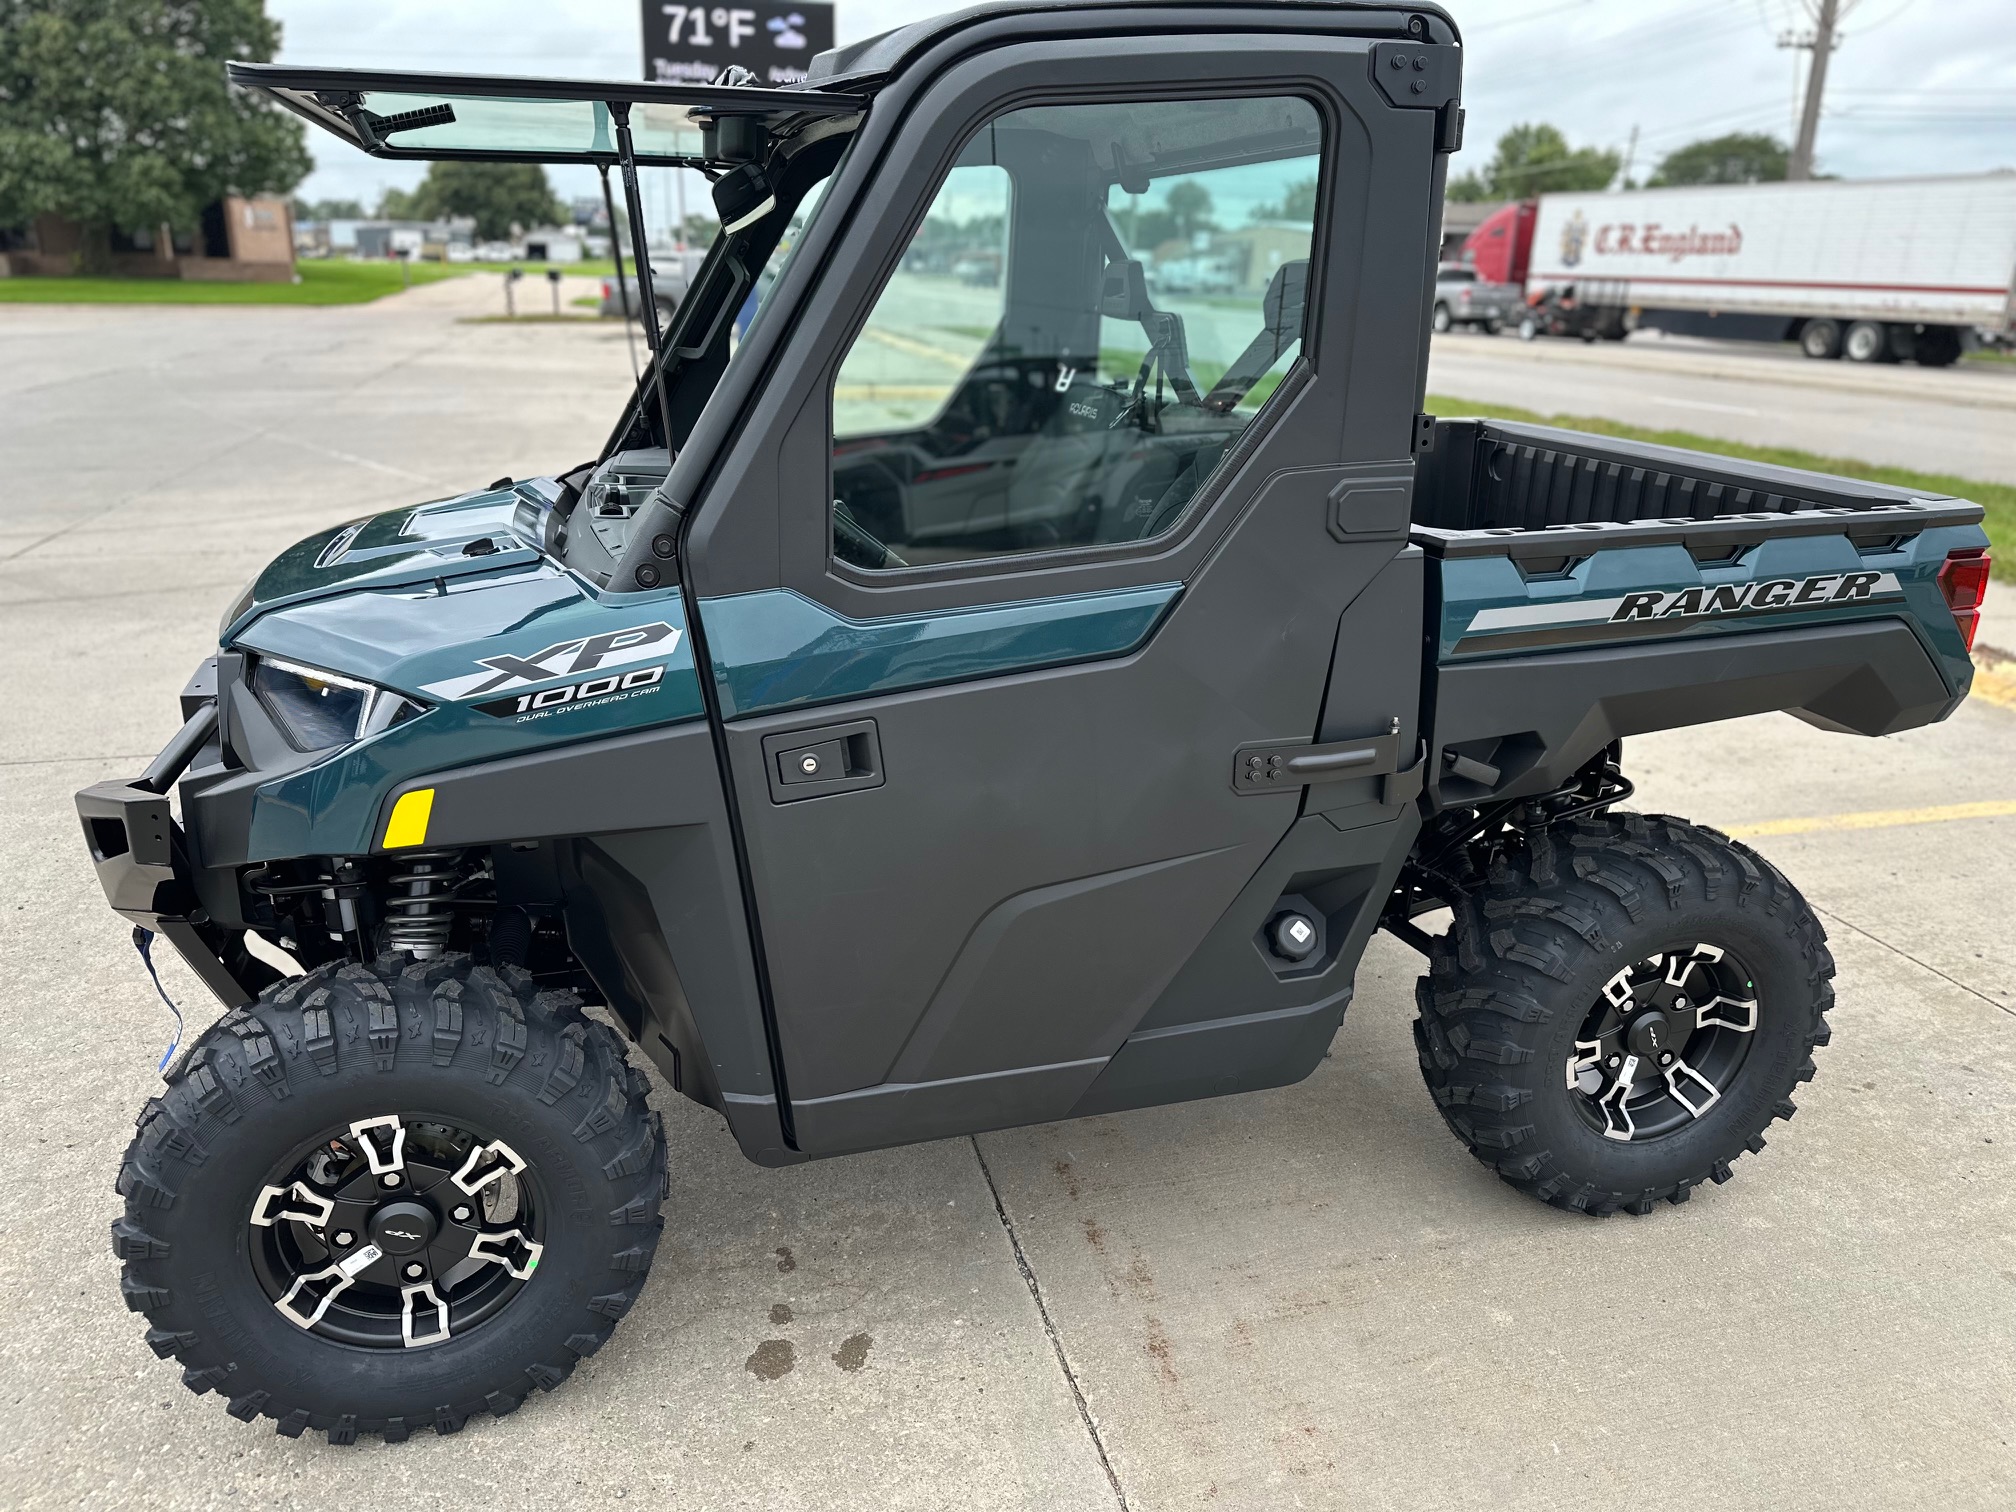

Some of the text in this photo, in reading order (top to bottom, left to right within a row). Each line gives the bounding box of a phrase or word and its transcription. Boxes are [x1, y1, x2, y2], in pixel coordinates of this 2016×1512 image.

[662, 5, 756, 48] 71°F
[652, 57, 719, 82] Tuesday
[1608, 571, 1882, 623] RANGER
[457, 621, 675, 699] XP
[516, 666, 664, 713] 1000
[516, 686, 661, 723] DUAL OVERHEAD CAM
